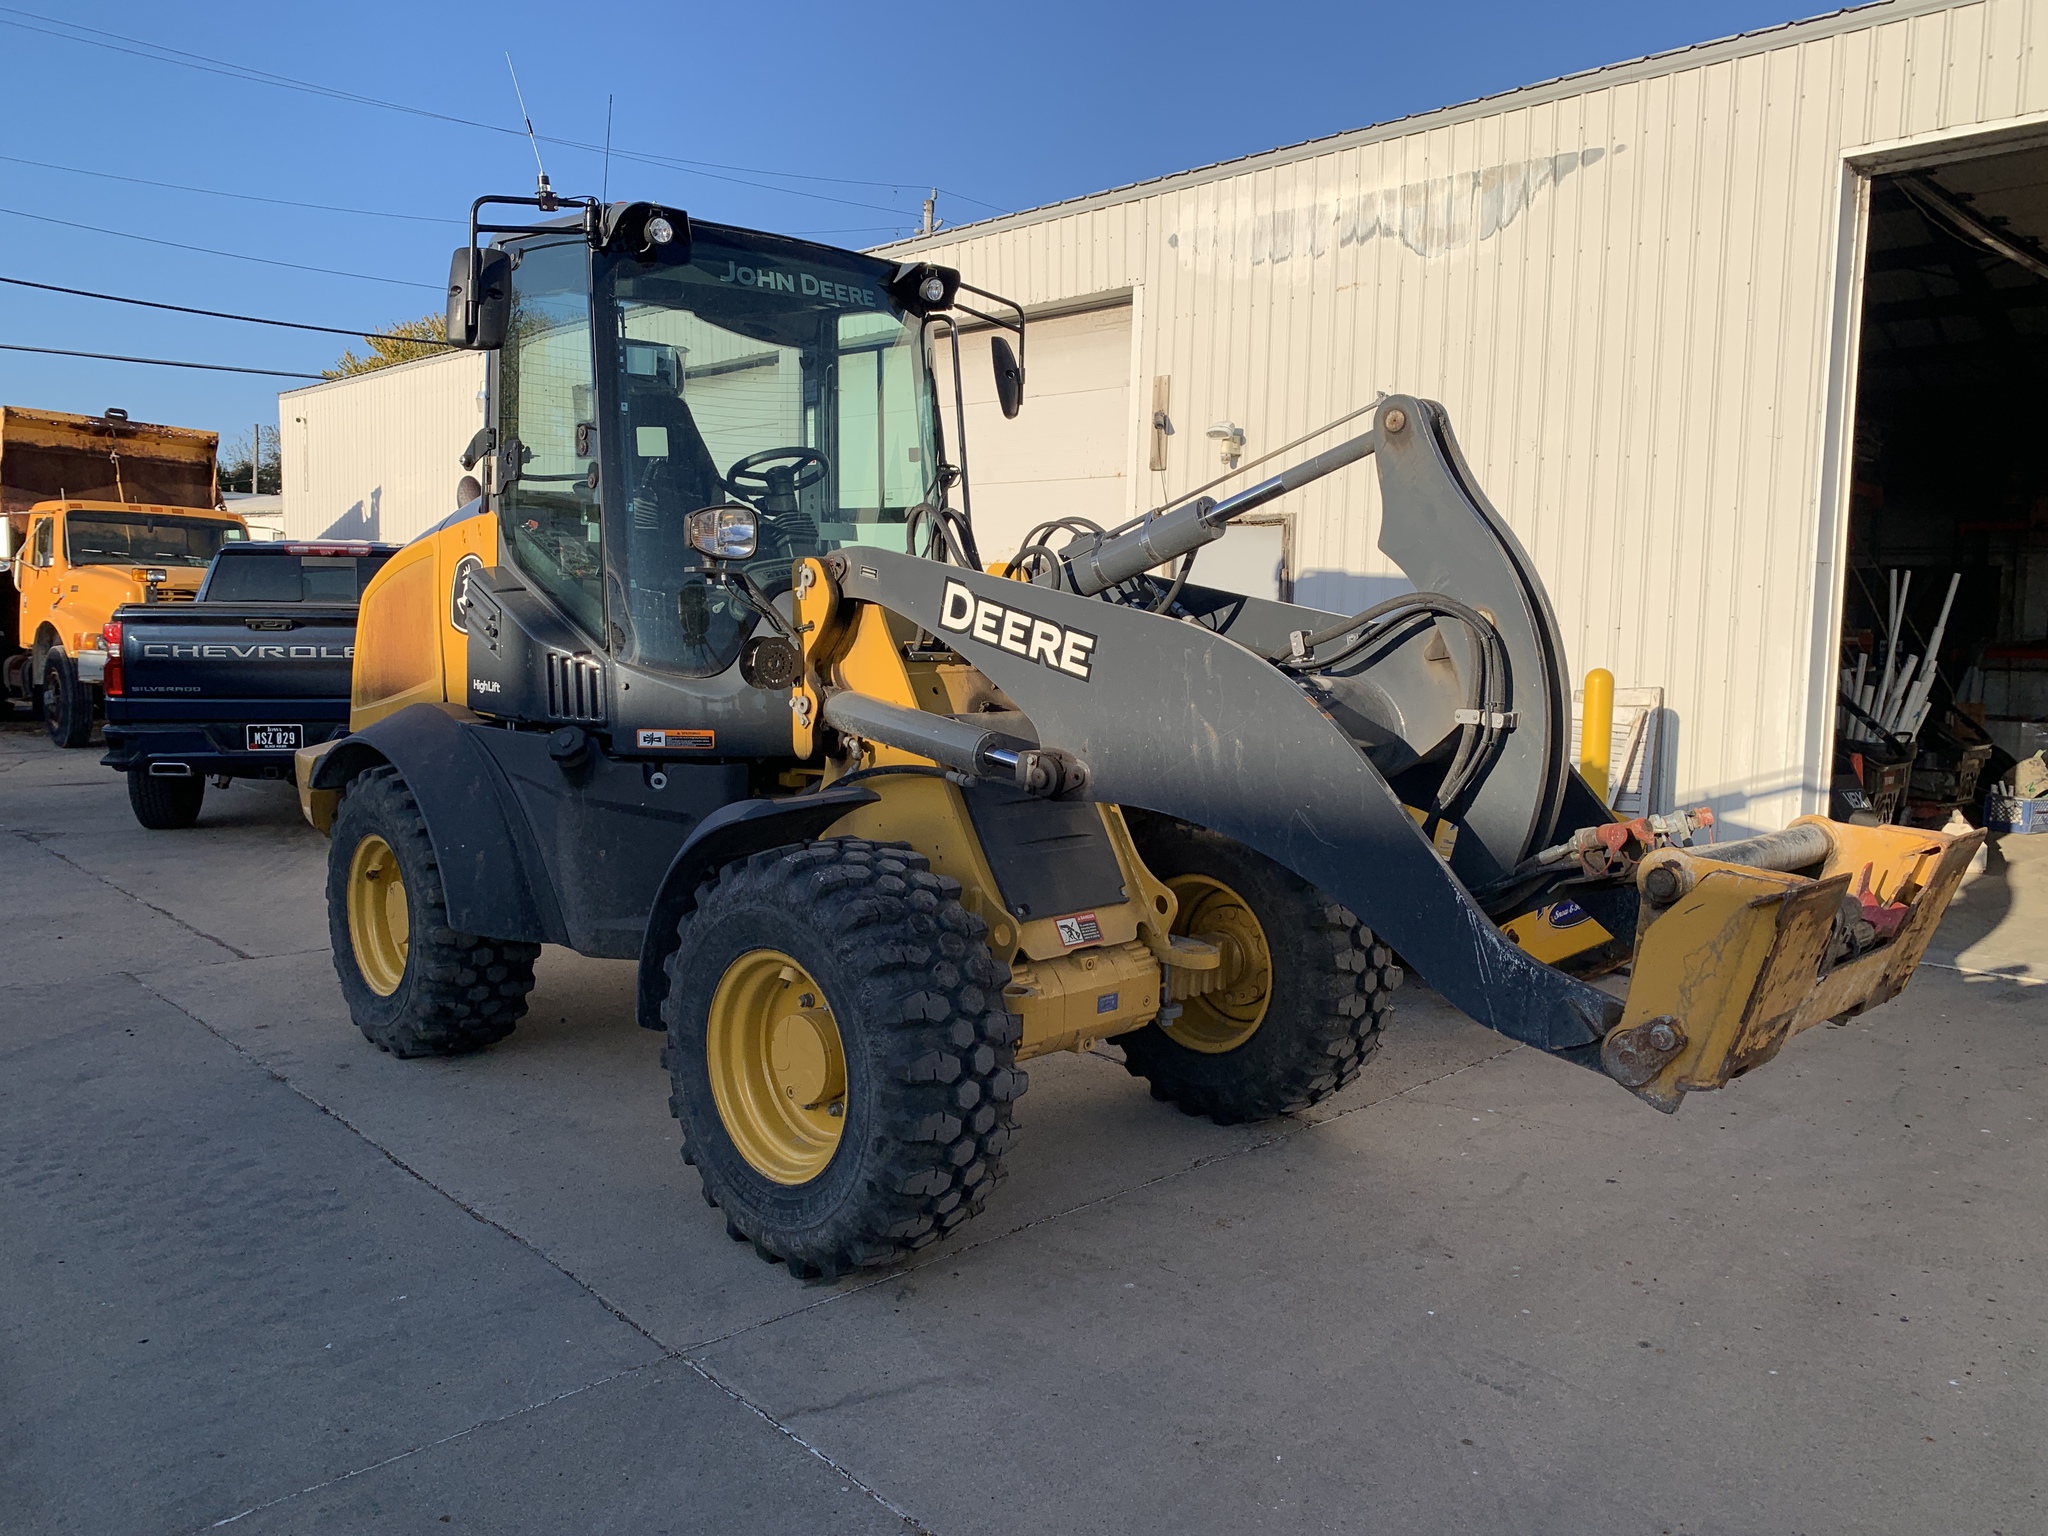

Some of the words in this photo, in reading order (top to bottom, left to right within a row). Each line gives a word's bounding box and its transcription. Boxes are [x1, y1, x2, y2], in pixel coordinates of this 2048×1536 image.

[720, 260, 795, 293] JOHN
[800, 272, 876, 307] DEERE
[941, 581, 1095, 678] DEERE
[144, 644, 354, 658] CHEVROLE
[254, 732, 273, 744] MSZ
[276, 732, 295, 744] 029
